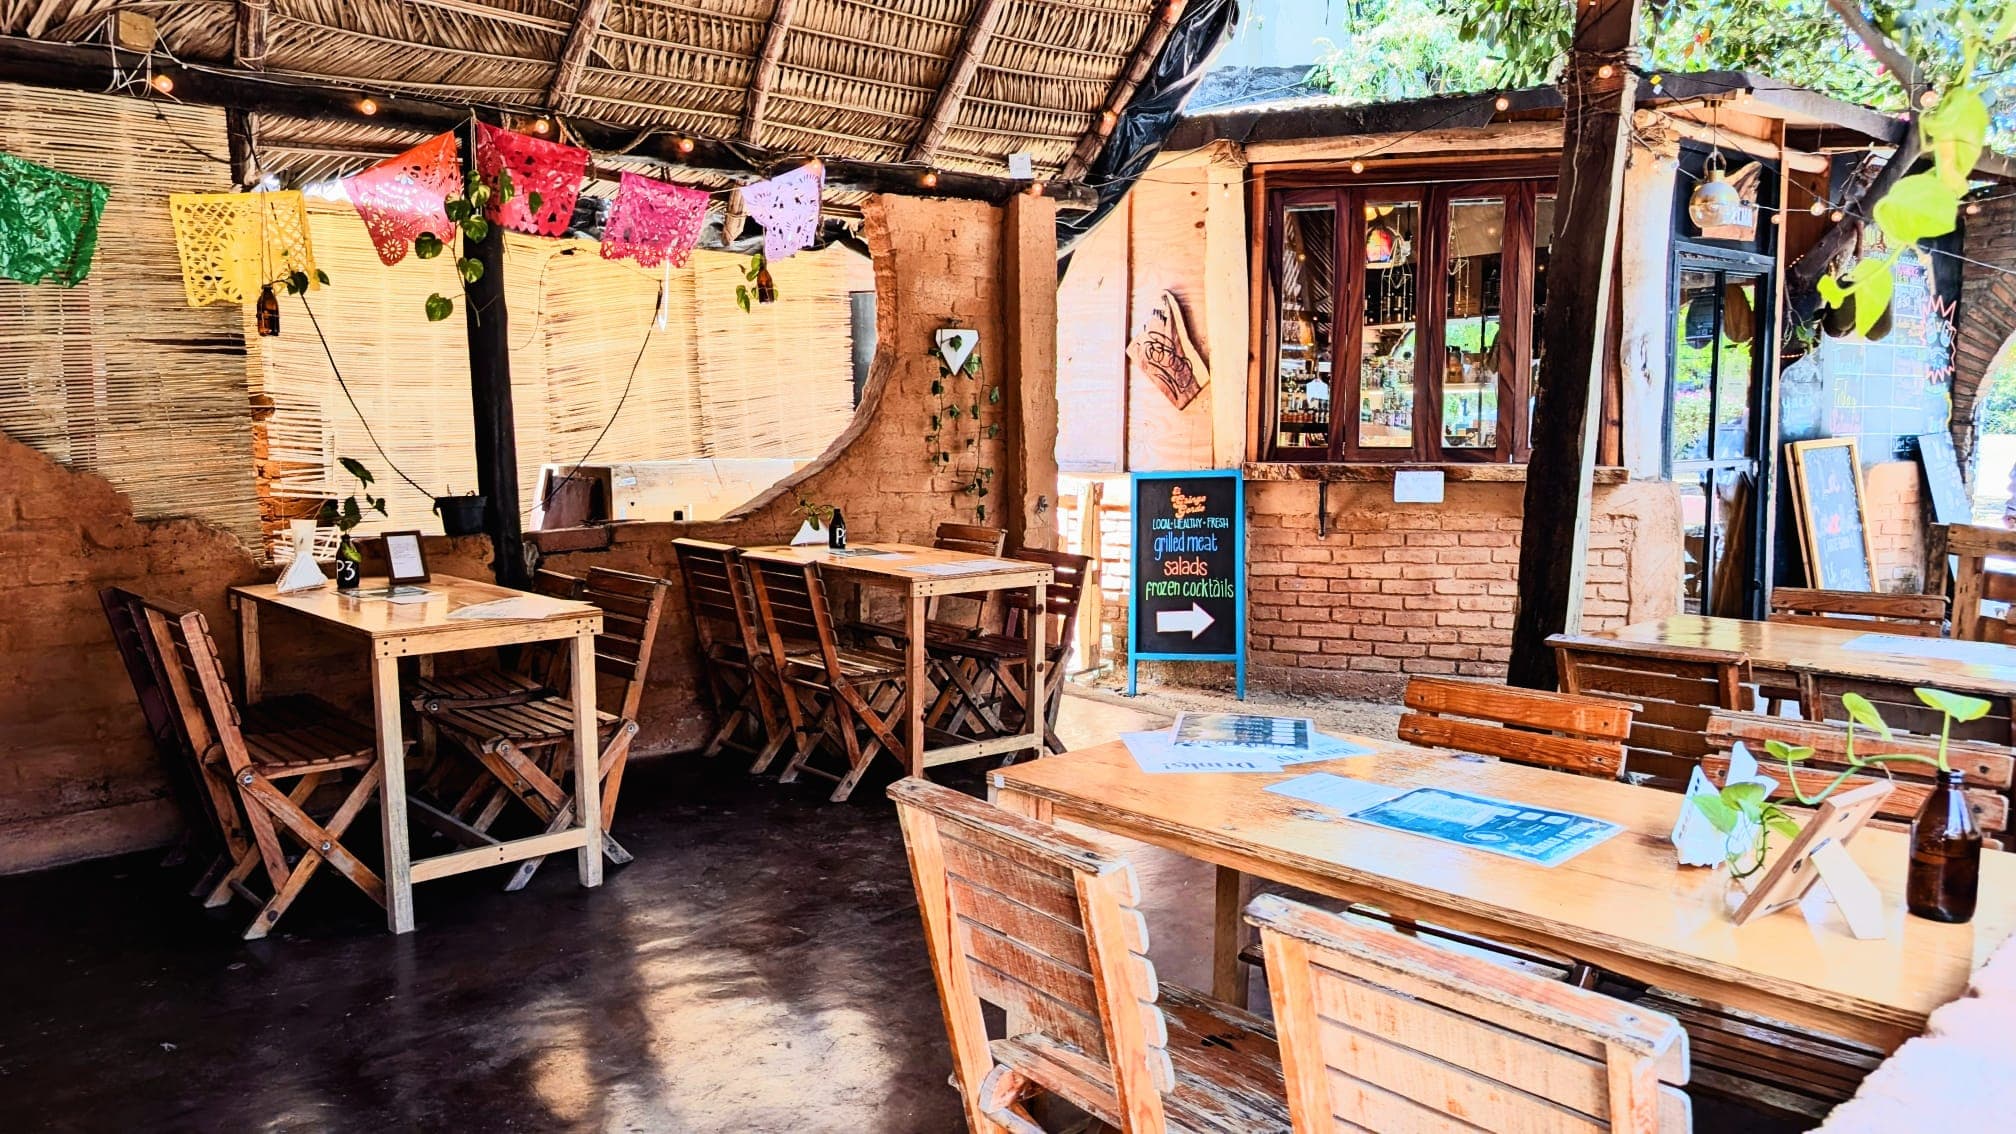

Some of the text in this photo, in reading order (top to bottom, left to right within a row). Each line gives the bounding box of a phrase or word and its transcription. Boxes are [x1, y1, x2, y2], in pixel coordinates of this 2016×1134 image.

[1153, 518, 1229, 530] LOCAL HEALTHY FRESH
[1154, 531, 1218, 561] grilled meat
[336, 560, 356, 581] P3
[1164, 555, 1208, 576] salads
[1146, 577, 1234, 600] frozen cocktails
